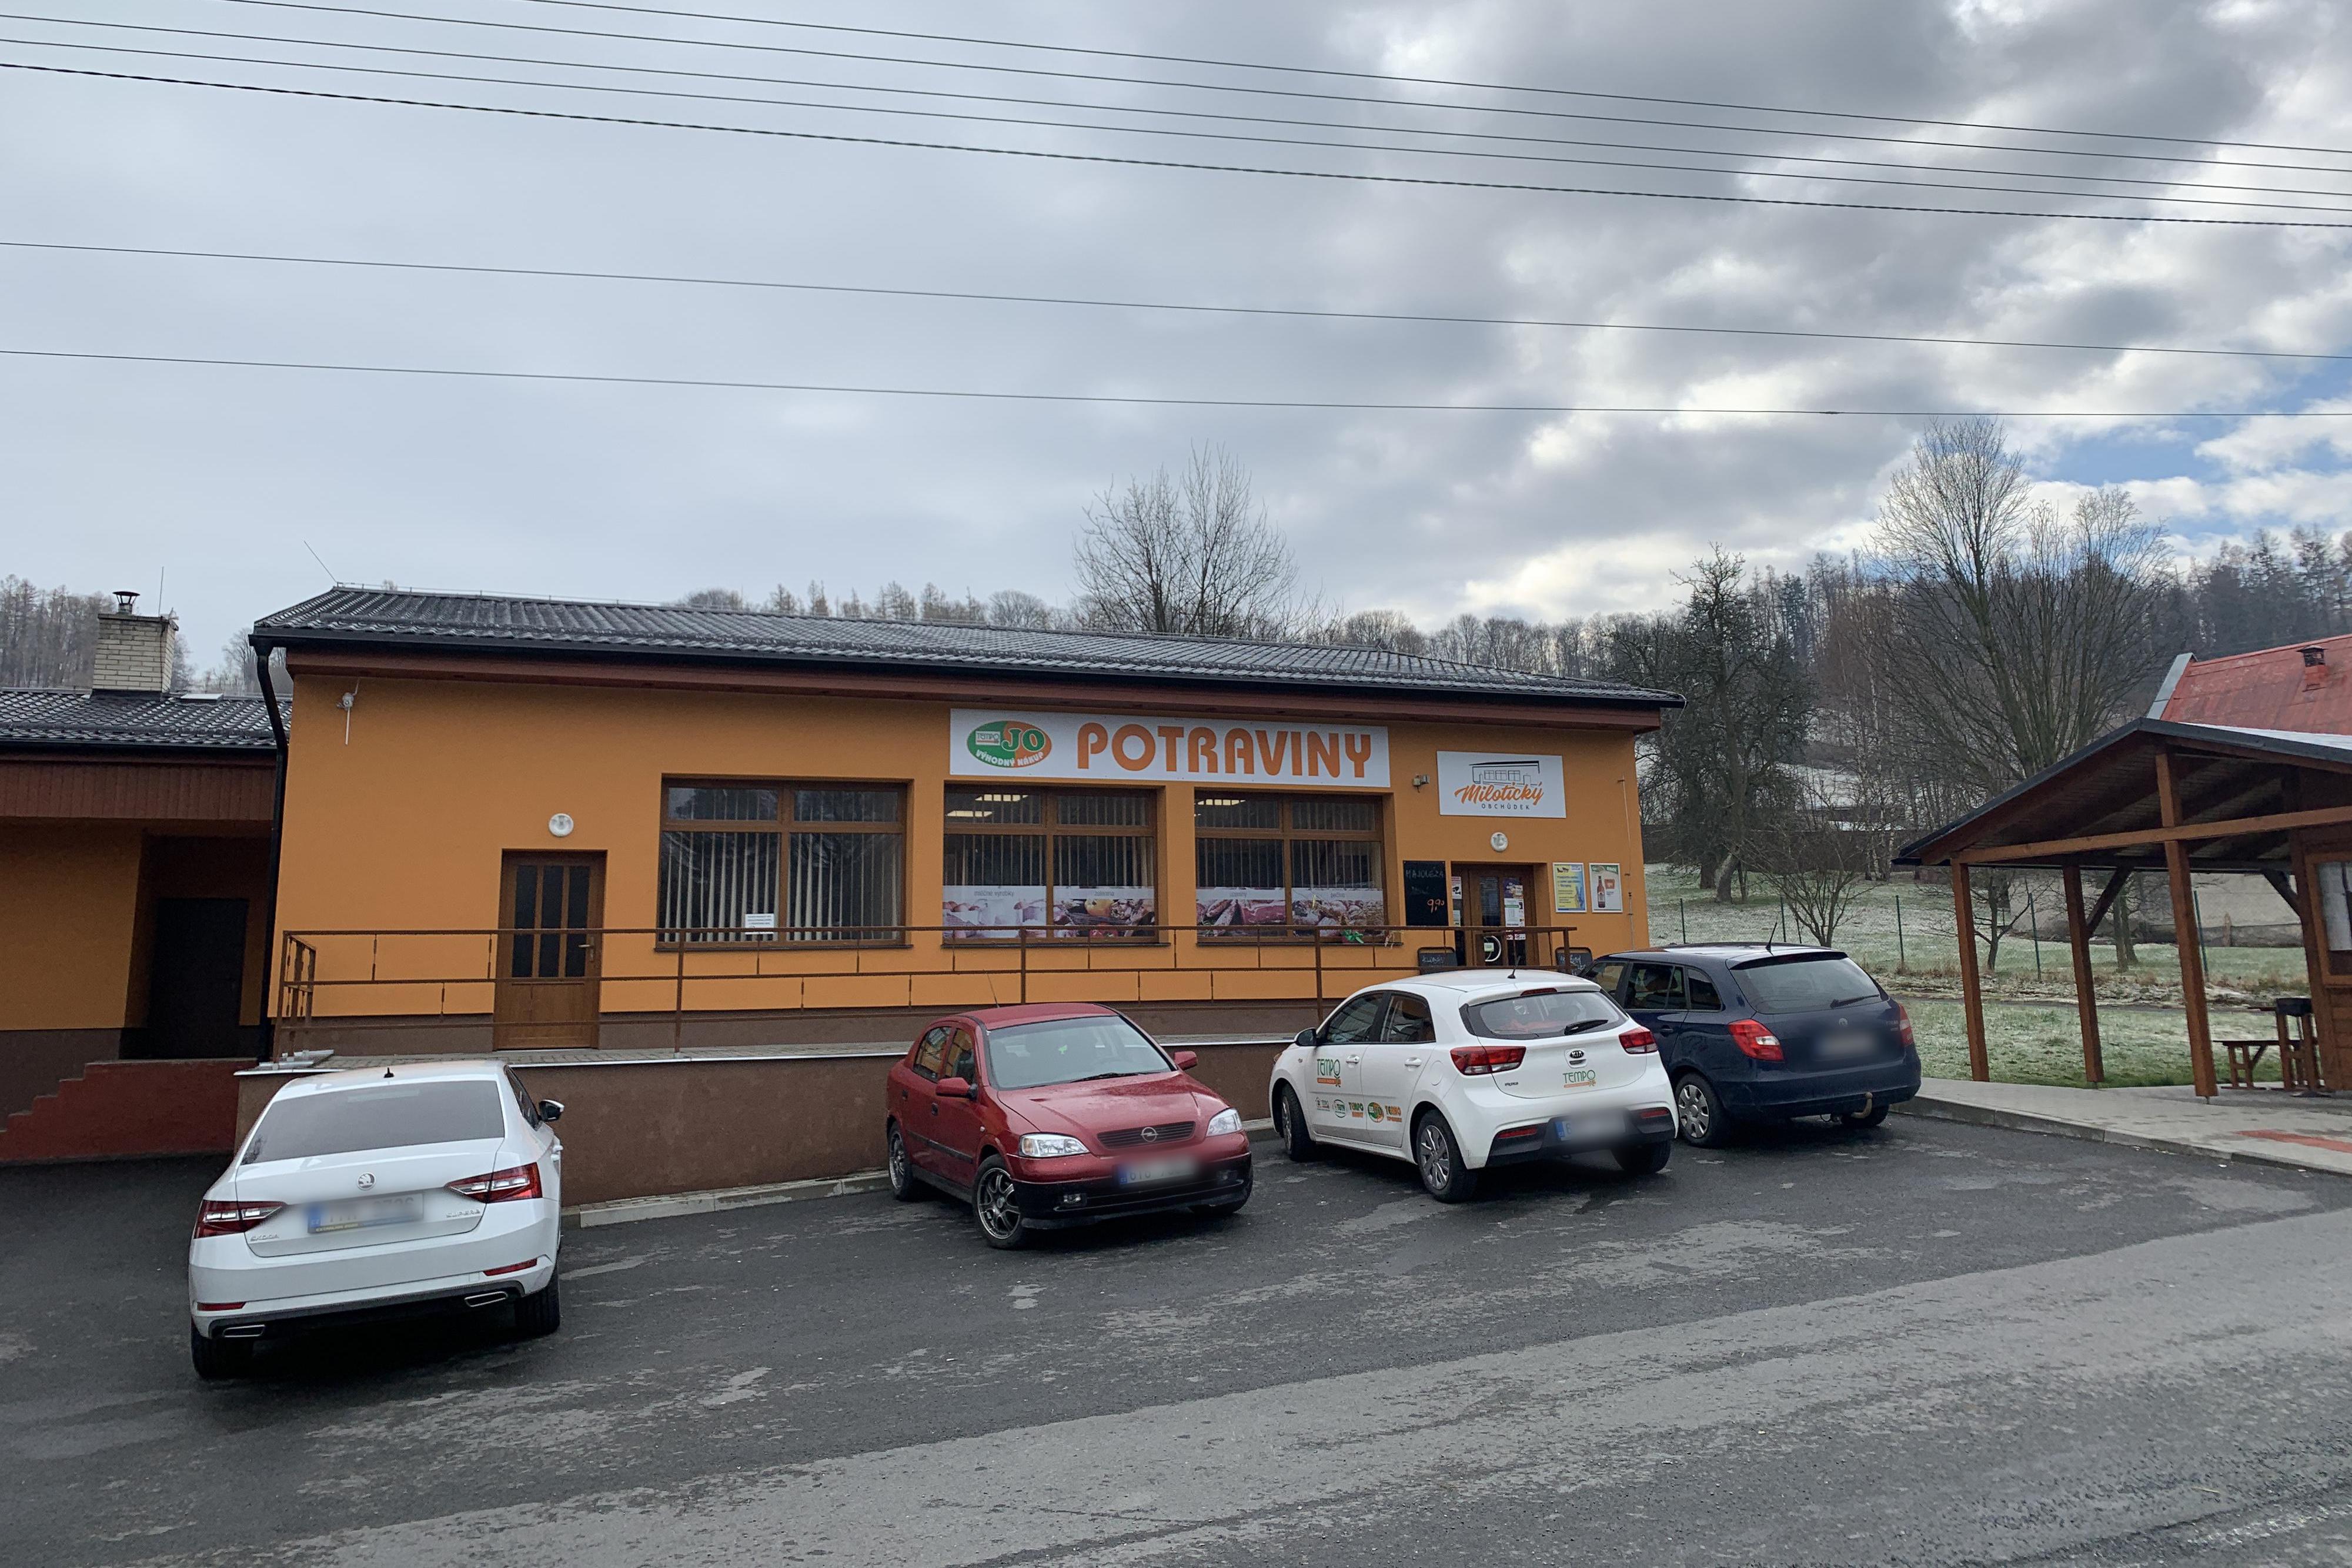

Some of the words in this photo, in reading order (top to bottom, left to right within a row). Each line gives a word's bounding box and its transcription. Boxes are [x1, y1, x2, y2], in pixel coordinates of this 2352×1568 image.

[1001, 728, 1045, 752] JO
[1077, 722, 1371, 778] POTRAVINY
[975, 749, 1014, 767] VÝHODNÝ
[1018, 751, 1044, 766] NÁKUP
[1454, 781, 1544, 806] Milotický
[1317, 1059, 1341, 1076] TEMPO
[1562, 1069, 1596, 1084] TEMPO
